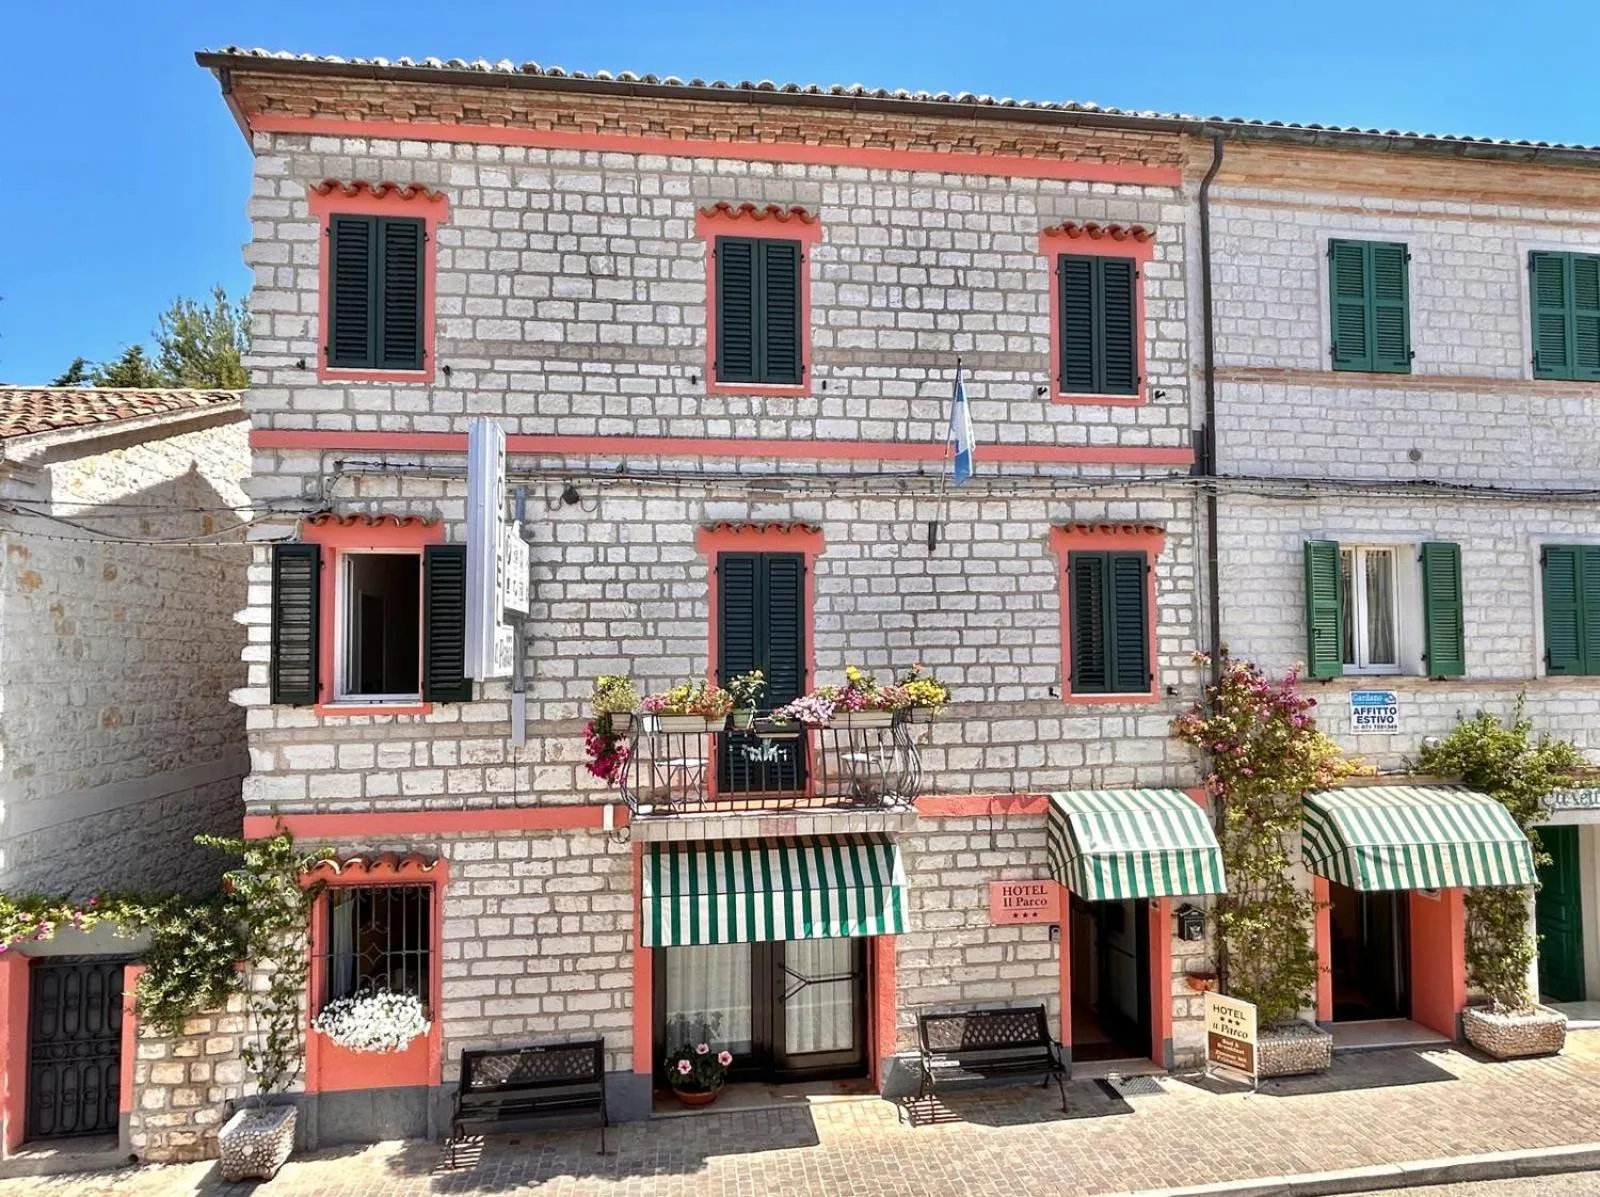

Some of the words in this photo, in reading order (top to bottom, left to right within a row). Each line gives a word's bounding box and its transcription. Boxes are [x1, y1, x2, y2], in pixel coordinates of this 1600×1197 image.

[1353, 707, 1397, 715] AFFITTO
[1357, 716, 1394, 724] ESTIVO
[1002, 885, 1048, 896] HOTEL
[1003, 897, 1012, 907] Il
[1016, 897, 1048, 906] Parco
[1212, 1004, 1247, 1020] HOTEL
[1221, 1024, 1248, 1039] Parco
